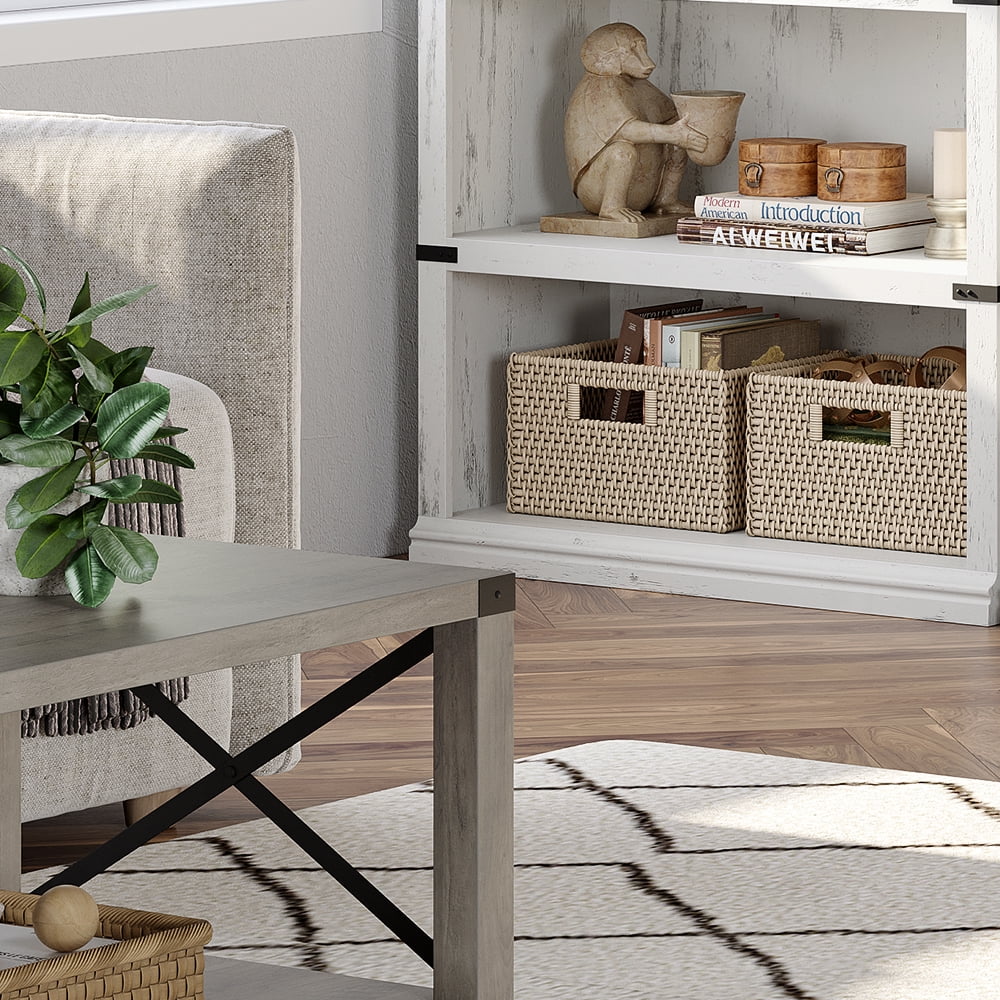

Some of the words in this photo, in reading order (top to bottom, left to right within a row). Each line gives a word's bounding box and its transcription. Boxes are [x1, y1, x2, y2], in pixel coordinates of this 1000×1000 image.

[703, 196, 740, 208] Modern
[700, 208, 748, 220] American
[760, 201, 862, 225] Introduction
